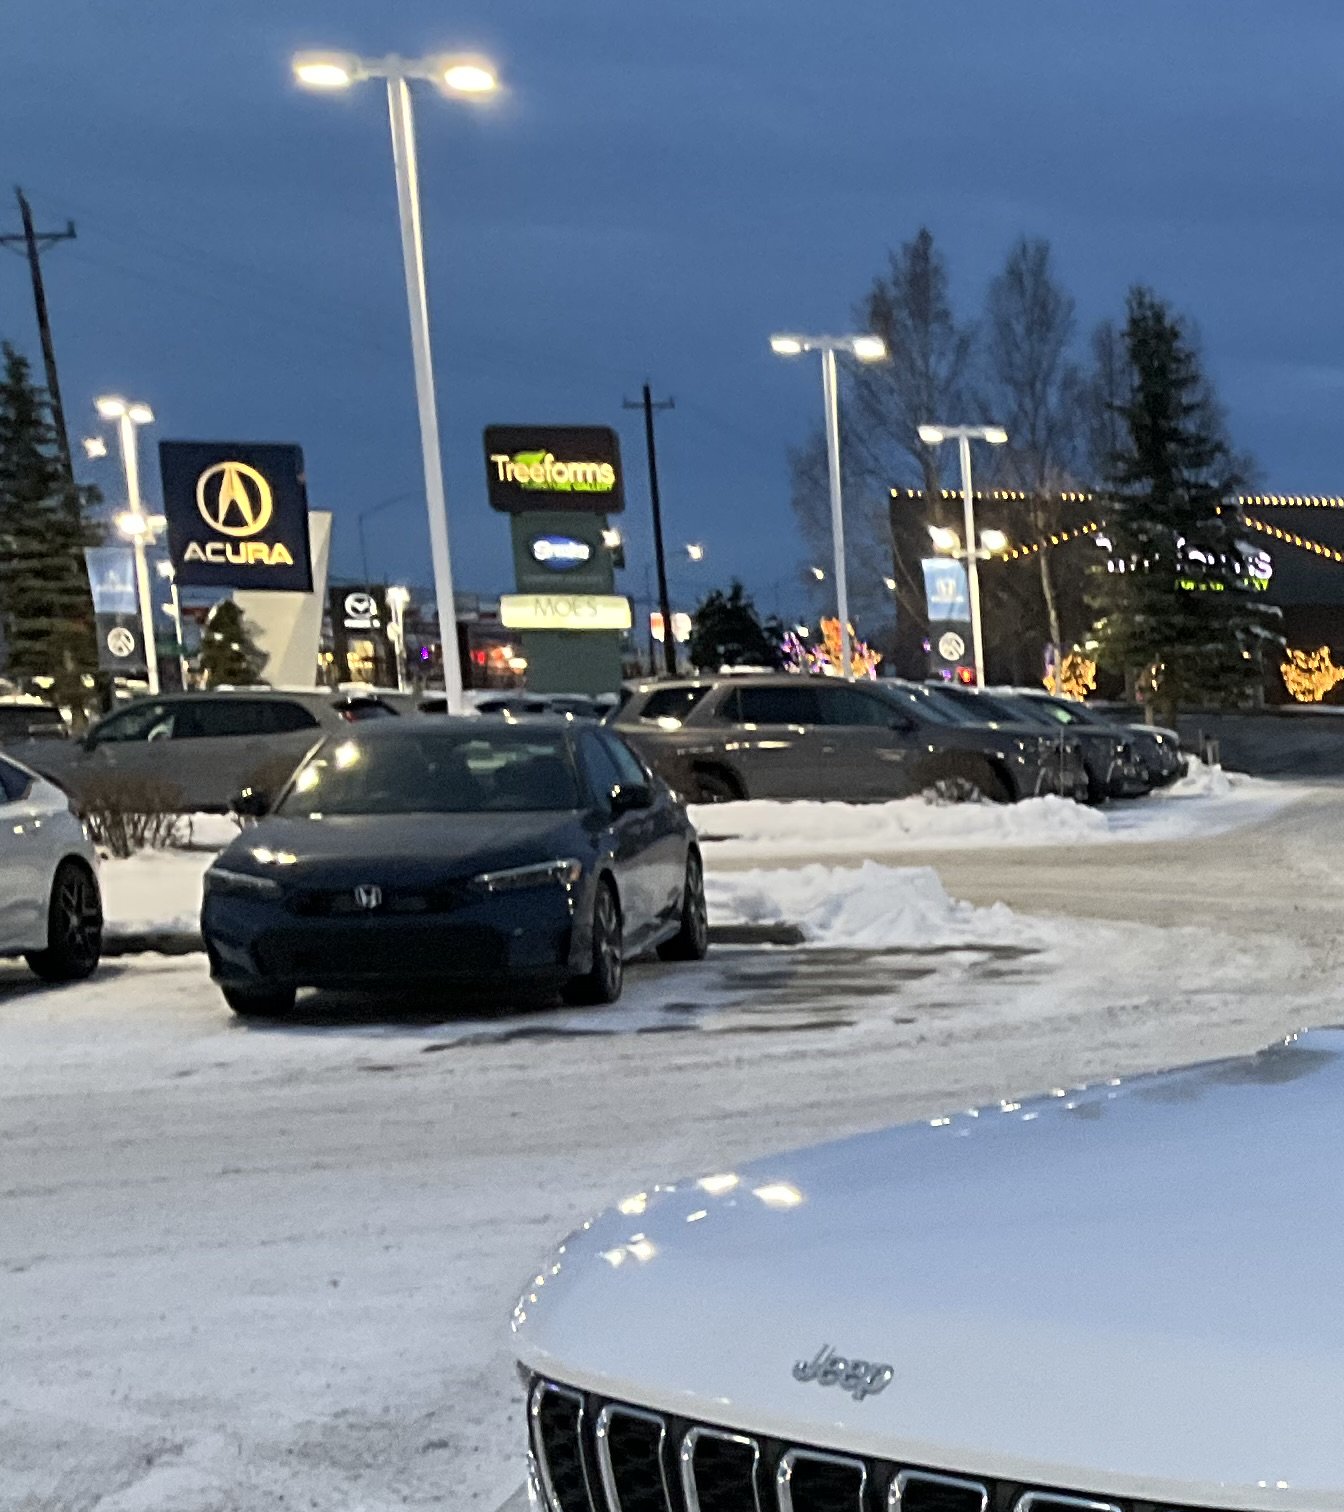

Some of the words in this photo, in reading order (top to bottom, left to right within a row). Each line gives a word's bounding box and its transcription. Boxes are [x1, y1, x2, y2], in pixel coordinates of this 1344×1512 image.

[490, 452, 616, 484] Treeforms
[183, 541, 294, 566] ACURA
[792, 1343, 895, 1402] Jeep
